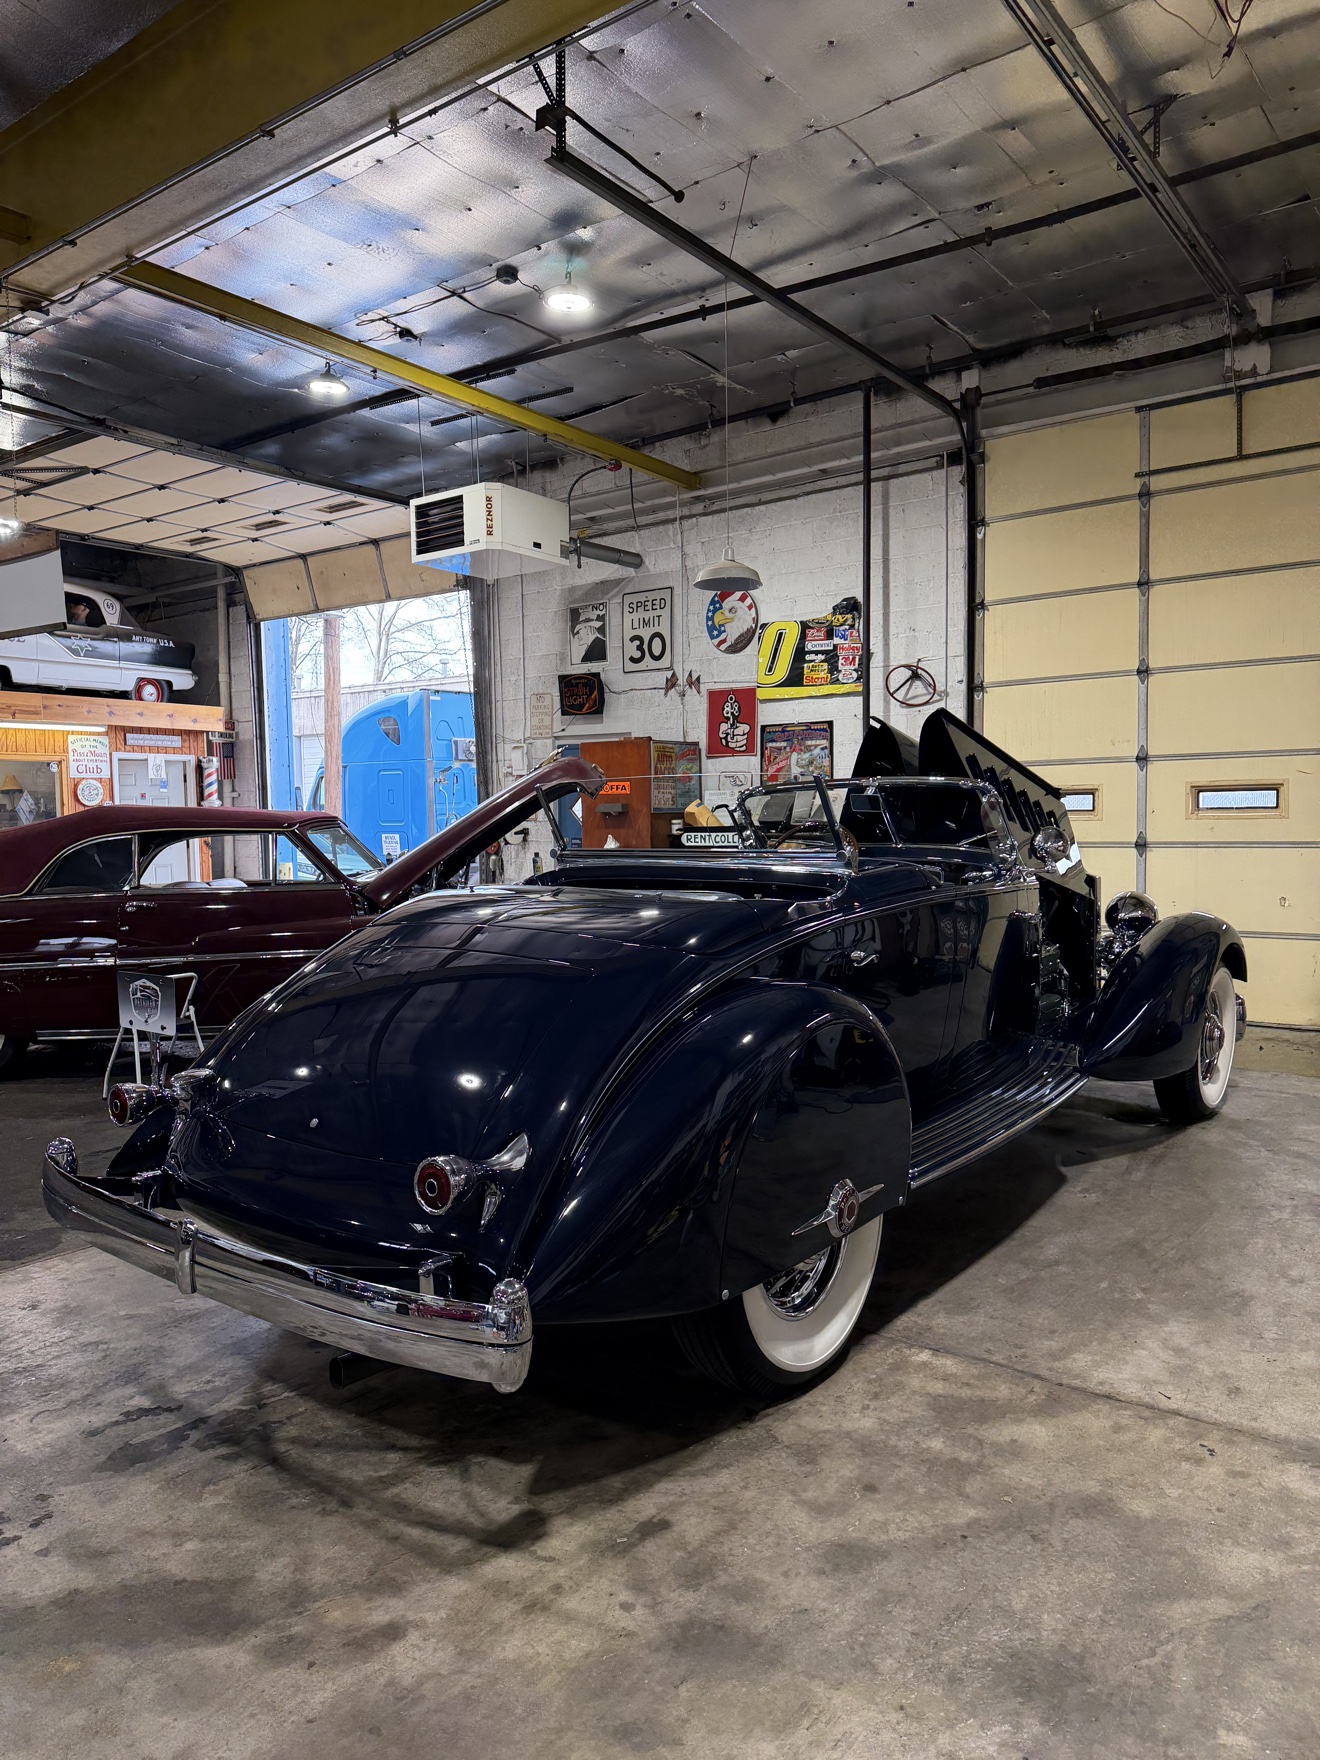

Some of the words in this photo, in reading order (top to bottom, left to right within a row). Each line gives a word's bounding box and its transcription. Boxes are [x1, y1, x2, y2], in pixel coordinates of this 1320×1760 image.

[486, 495, 494, 536] REZNOR
[628, 597, 667, 614] SPEED
[631, 615, 662, 630] LIMIT
[628, 631, 667, 664] 30
[805, 642, 832, 650] Commit
[838, 644, 861, 654] Holley
[841, 655, 856, 667] 3M
[804, 676, 829, 686] Stant
[564, 687, 590, 696] STROH
[565, 696, 588, 705] LIGHT
[76, 764, 103, 774] Club
[602, 784, 627, 793] OFFA
[686, 834, 710, 844] RENT
[713, 834, 740, 844] COLL
